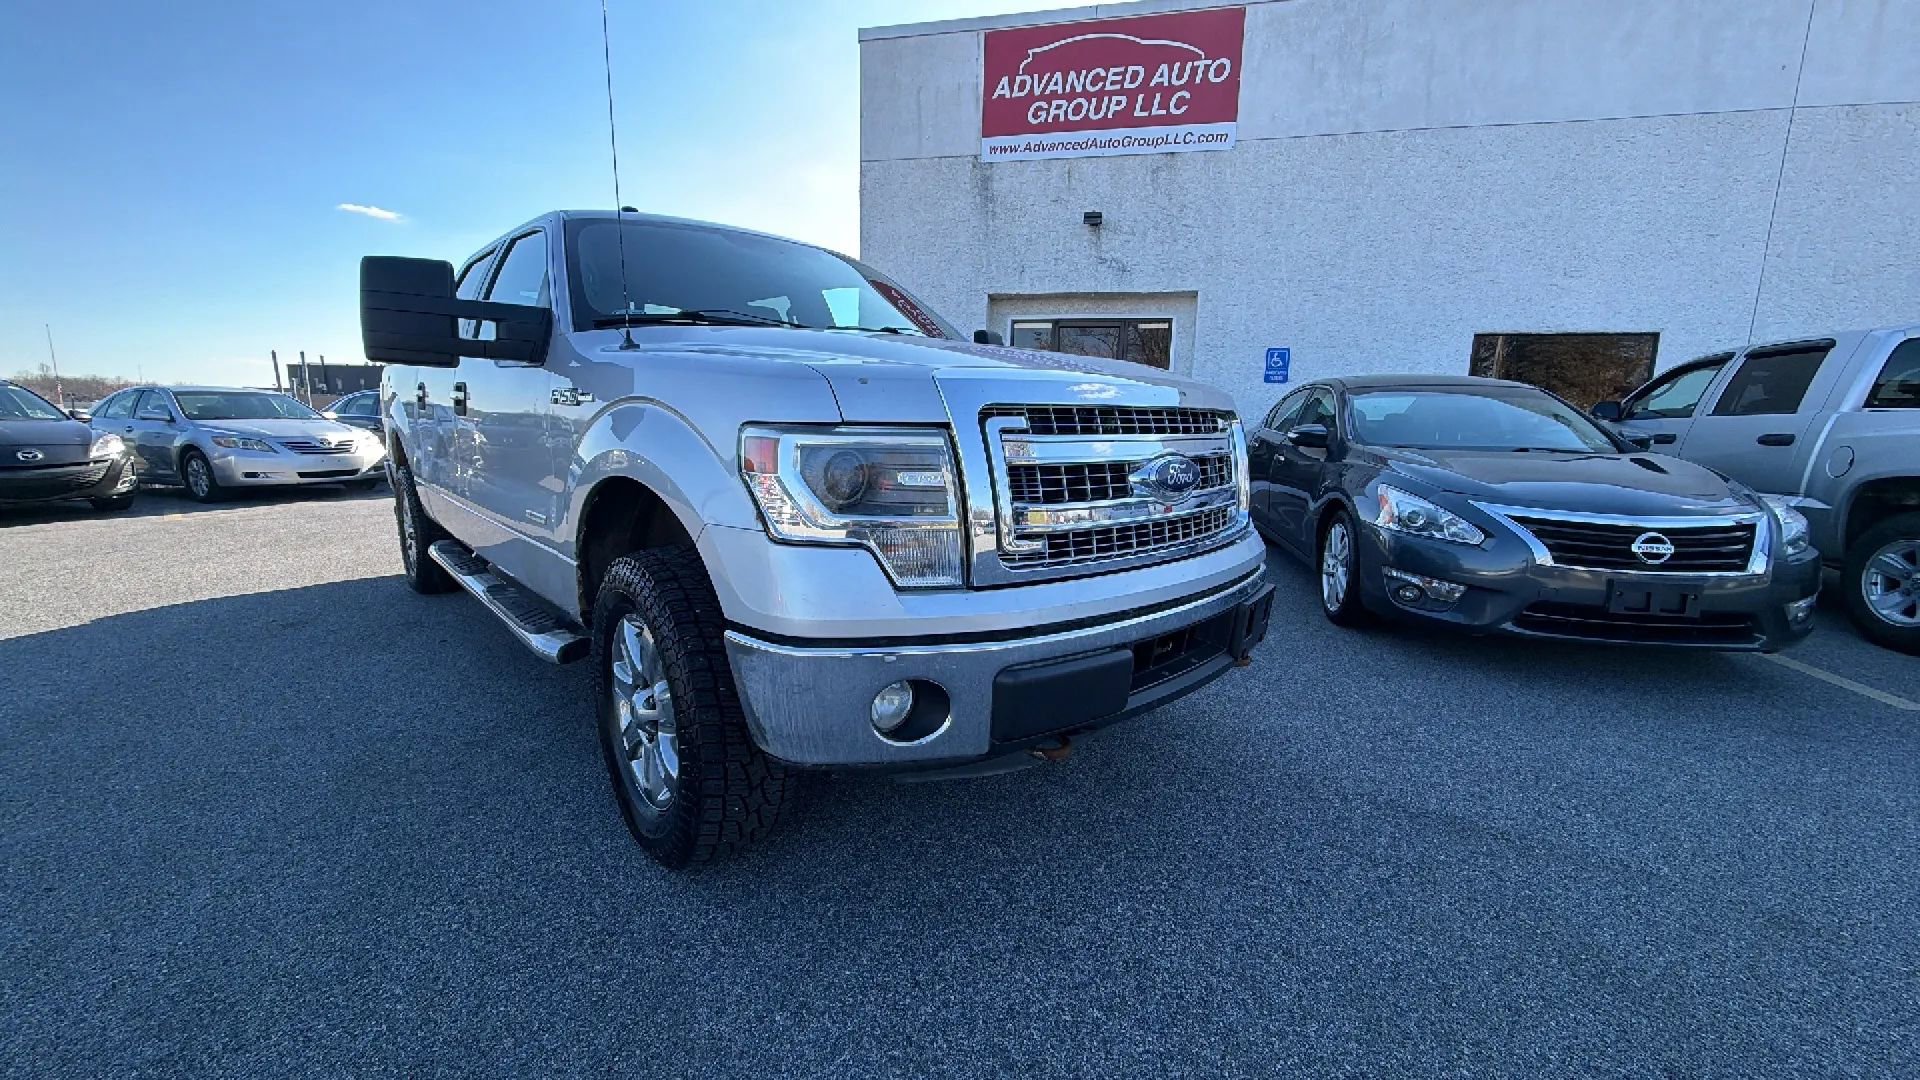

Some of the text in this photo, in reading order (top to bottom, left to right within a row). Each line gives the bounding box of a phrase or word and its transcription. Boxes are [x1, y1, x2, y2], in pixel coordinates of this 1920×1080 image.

[992, 57, 1231, 99] ADVANCED AUTO
[1027, 91, 1191, 124] GROUP LLC
[988, 131, 1229, 155] www.AdvancedAutoGroupLLC.com
[1167, 463, 1193, 485] Ford
[1637, 544, 1673, 552] NISSAN
